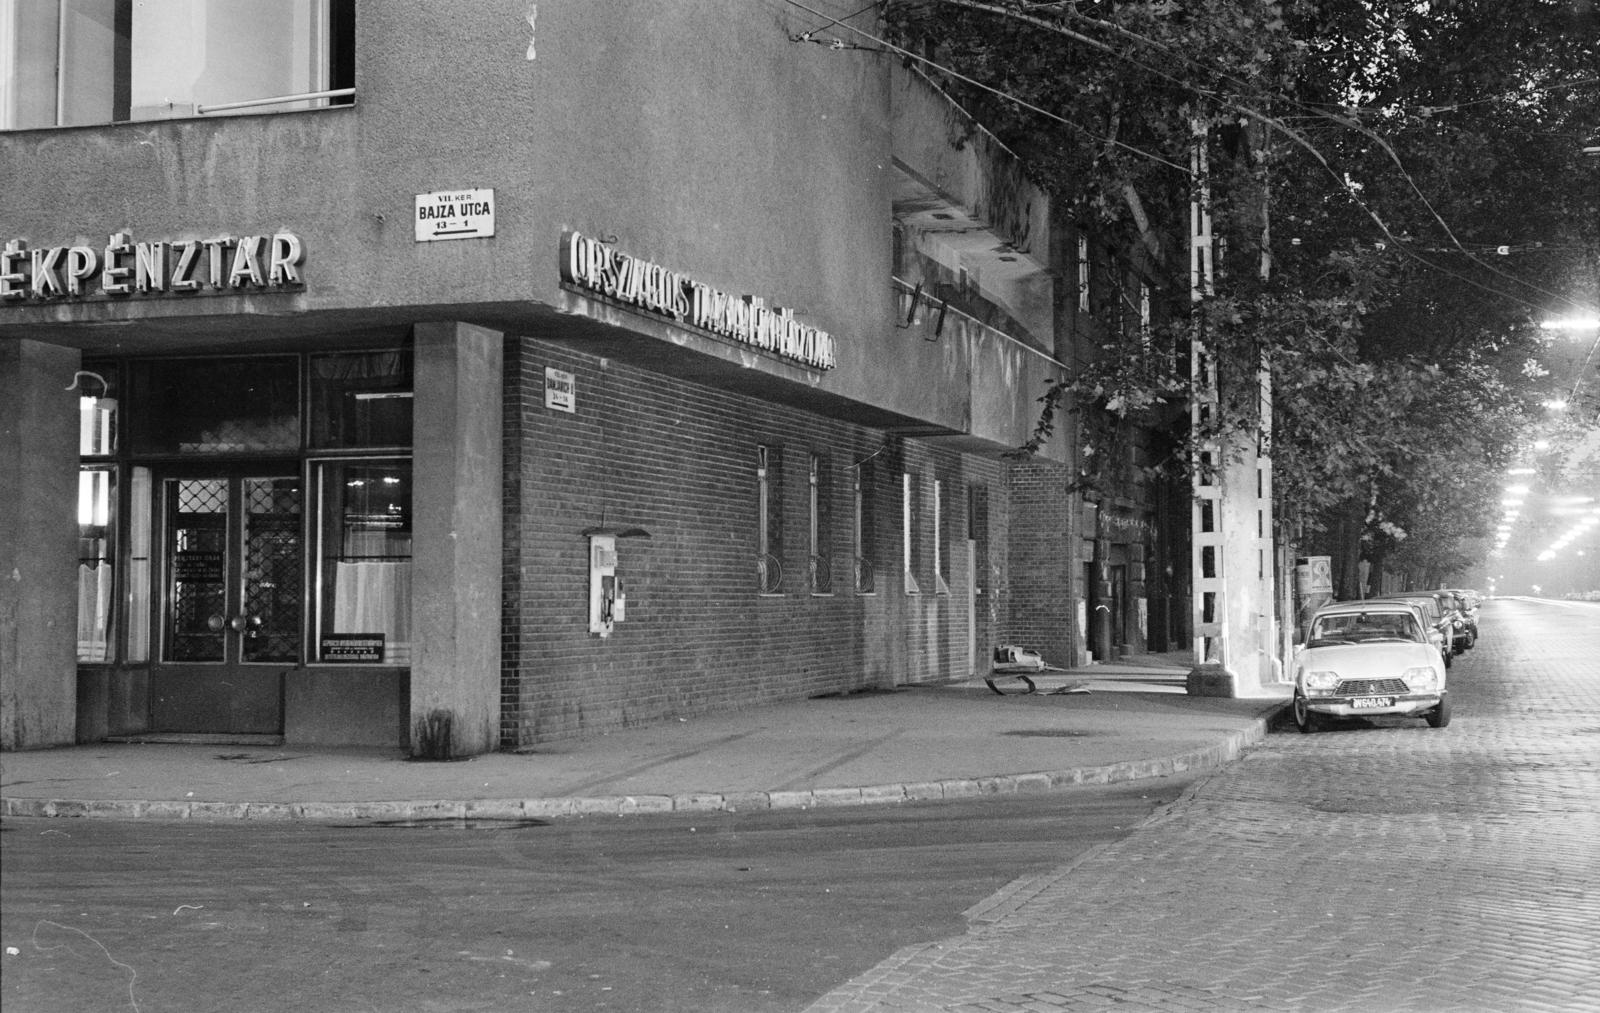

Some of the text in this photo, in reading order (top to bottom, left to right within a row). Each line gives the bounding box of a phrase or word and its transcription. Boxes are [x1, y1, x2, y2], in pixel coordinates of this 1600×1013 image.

[419, 202, 490, 220] BAJZA UTCA
[436, 221, 447, 229] 13
